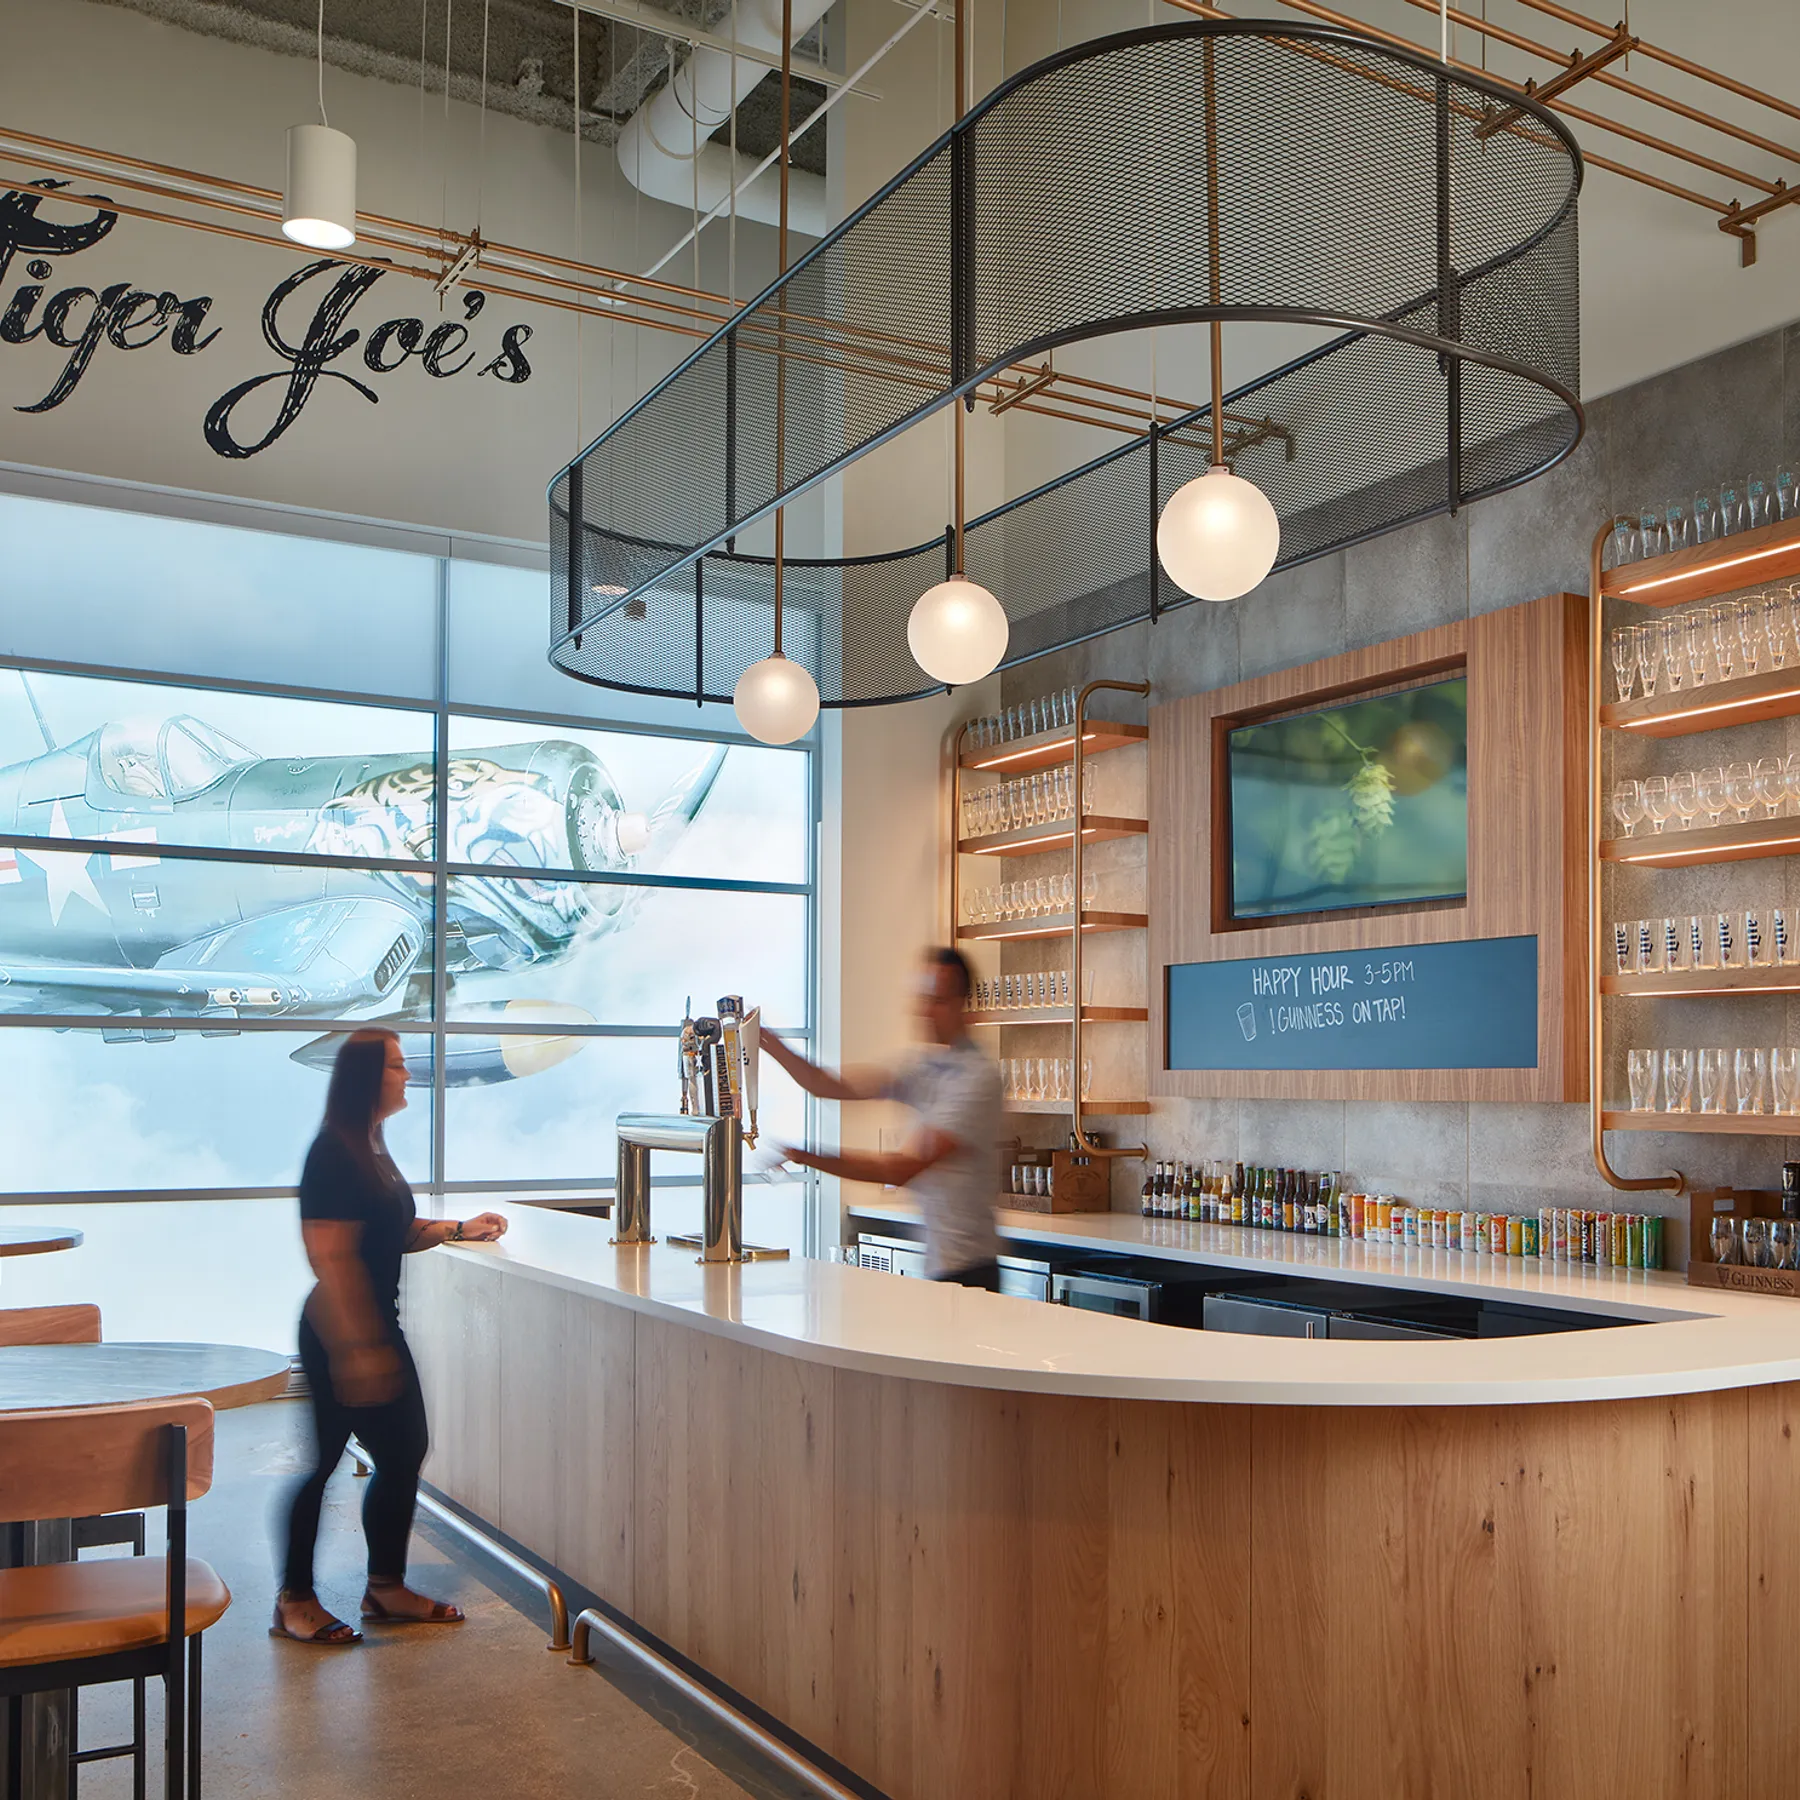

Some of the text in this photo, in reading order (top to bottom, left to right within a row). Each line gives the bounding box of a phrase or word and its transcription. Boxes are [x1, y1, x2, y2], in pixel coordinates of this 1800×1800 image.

[203, 256, 534, 460] Joe's
[1252, 960, 1416, 997] HAPPY HOUR 3-5PM
[1352, 1000, 1372, 1024] ON
[1373, 995, 1407, 1023] TAP!
[1731, 1271, 1795, 1291] GUINNESS
